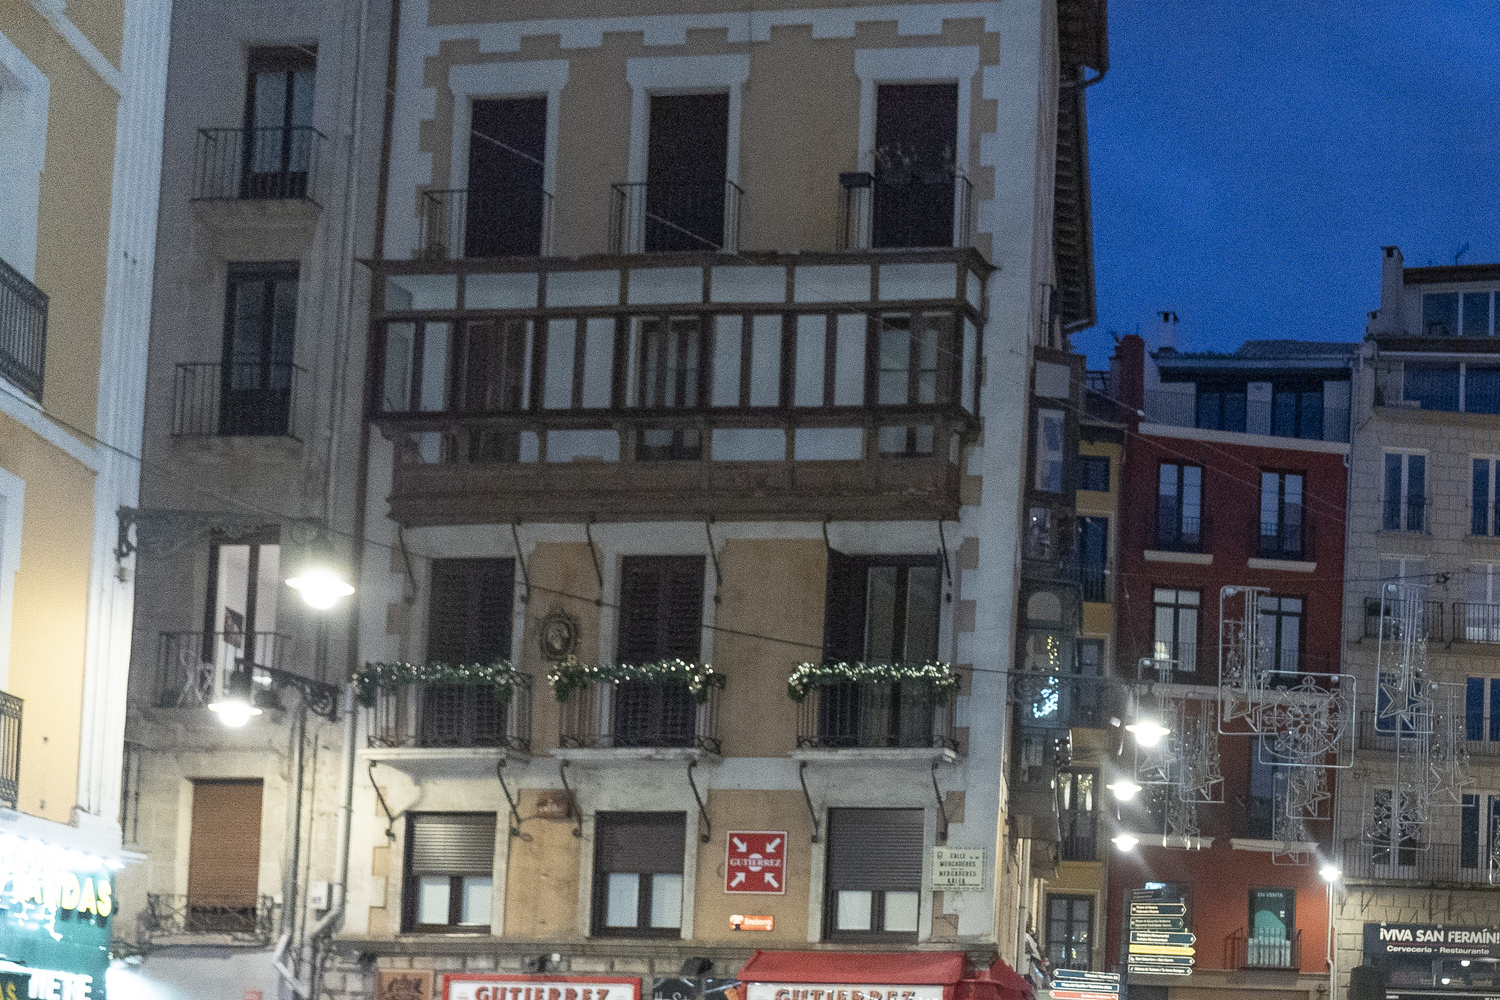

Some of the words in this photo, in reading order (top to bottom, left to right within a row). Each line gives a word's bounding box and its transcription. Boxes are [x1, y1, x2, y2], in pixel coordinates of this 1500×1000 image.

[730, 858, 782, 867] GUTIERREZ
[1379, 927, 1413, 941] ¡VIVA
[1415, 930, 1445, 943] SAN
[1447, 928, 1500, 945] FERMÍN!
[1386, 945, 1433, 953] Cervecería
[1439, 947, 1490, 955] Restaurante
